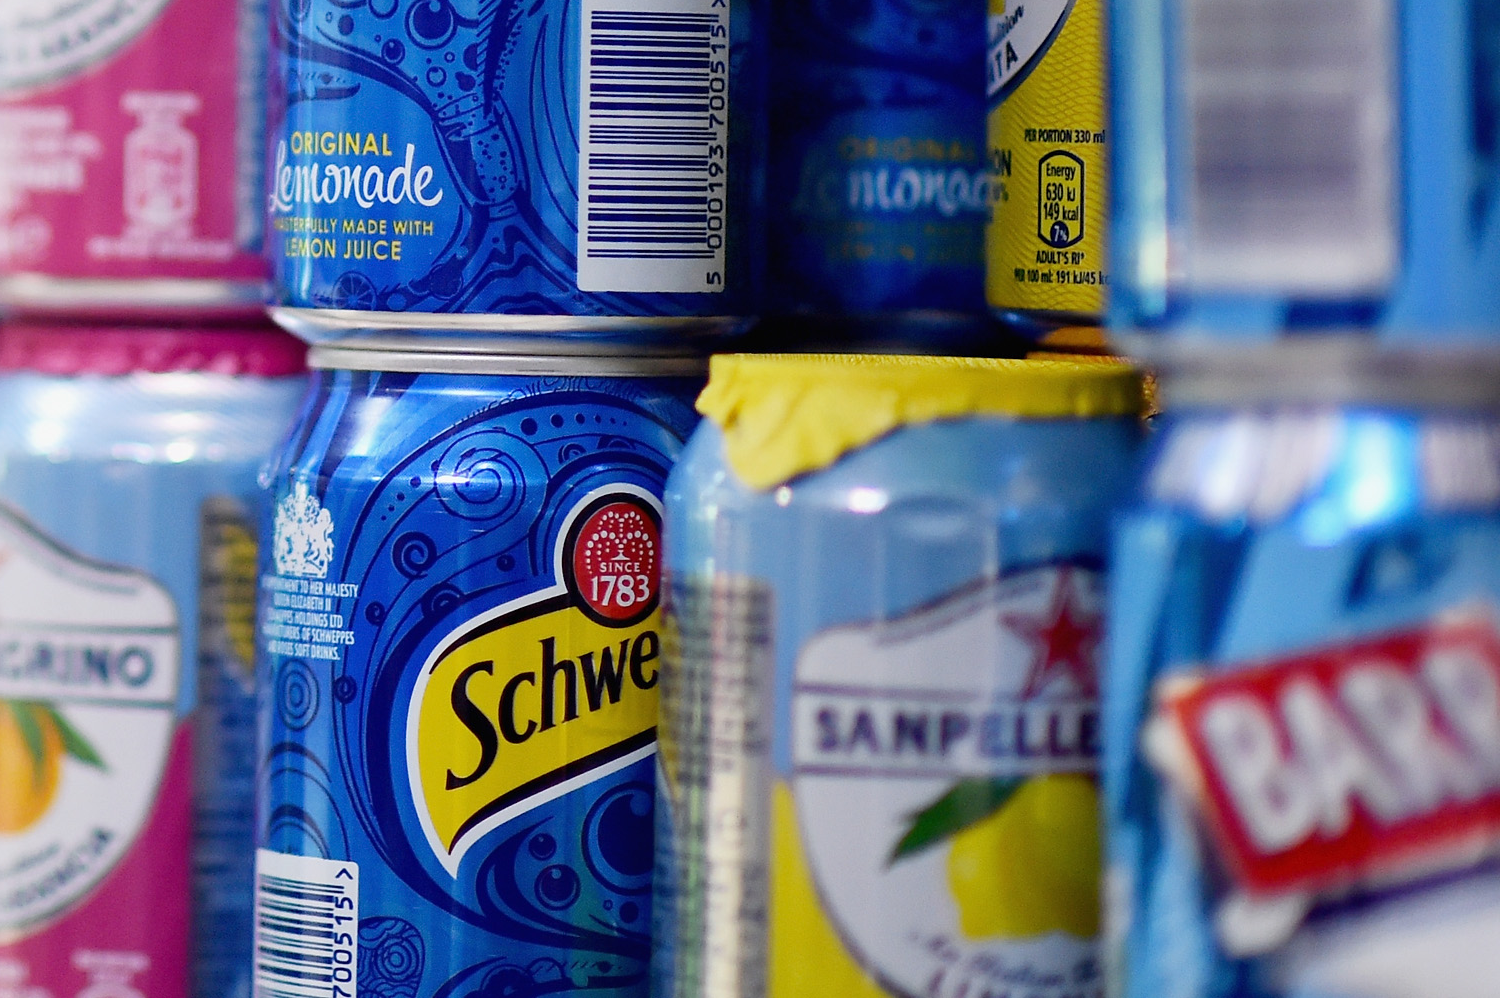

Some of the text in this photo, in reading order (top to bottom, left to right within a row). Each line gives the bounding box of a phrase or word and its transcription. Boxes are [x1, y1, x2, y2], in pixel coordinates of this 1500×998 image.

[709, 24, 726, 129] 700515
[290, 131, 393, 157] ORIGINAL
[1024, 128, 1036, 142] PER
[1038, 129, 1072, 143] PORTION
[1074, 129, 1090, 143] 330
[268, 139, 443, 212] Lemonade
[1046, 162, 1076, 181] Energy
[707, 143, 724, 250] 000193
[1045, 183, 1076, 202] 630 kJ
[1043, 202, 1079, 221] 149 kcal
[342, 219, 387, 235] MADE
[393, 220, 434, 236] WITH
[1053, 225, 1067, 242] 7%
[285, 238, 402, 261] LEMON JUICE
[1036, 250, 1069, 265] ADULT'S
[706, 270, 722, 285] 5
[1027, 269, 1039, 283] 100
[1056, 270, 1071, 284] 191
[599, 562, 641, 573] SINCE
[325, 582, 359, 599] MAJESTY
[591, 574, 650, 607] 1783
[329, 614, 343, 629] LTD
[312, 628, 355, 646] SCHWEPPES
[444, 629, 660, 791] Schwe
[812, 706, 1102, 761] SANPELLE
